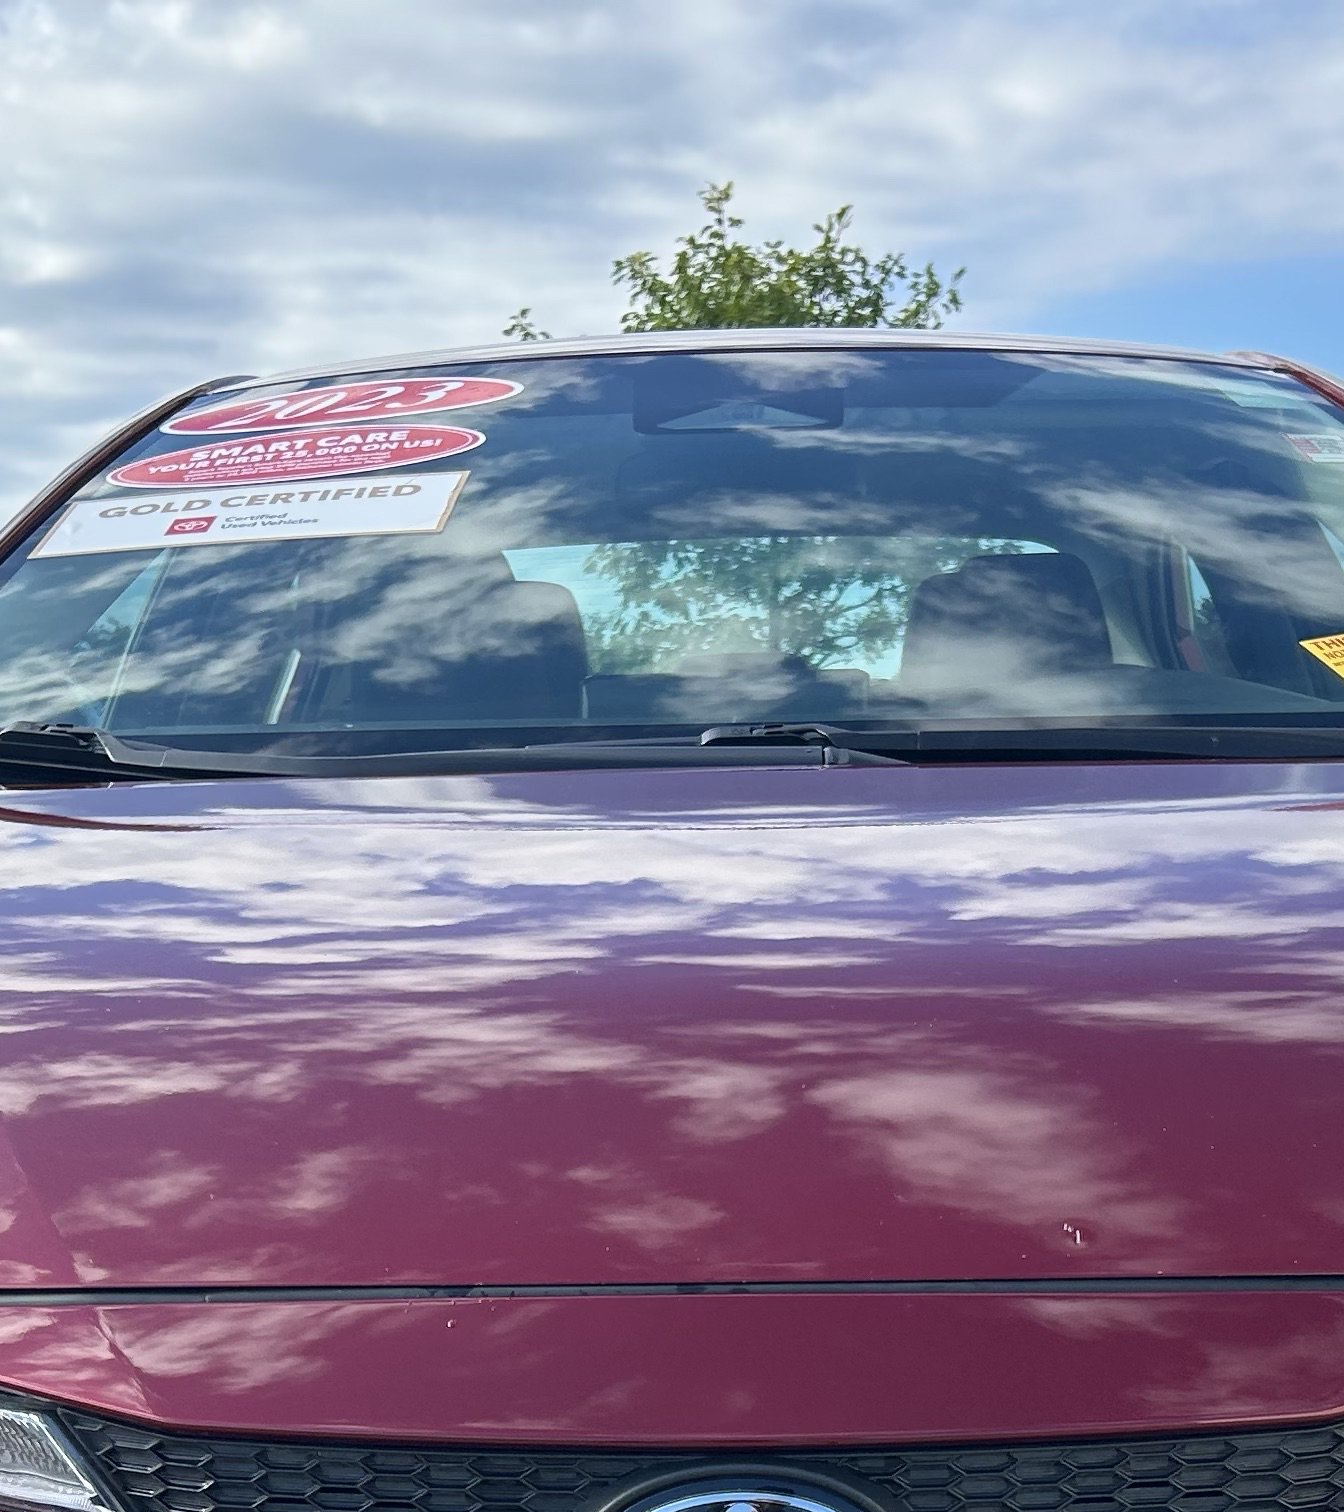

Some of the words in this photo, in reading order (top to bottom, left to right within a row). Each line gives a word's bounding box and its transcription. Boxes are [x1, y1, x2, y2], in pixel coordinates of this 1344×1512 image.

[207, 381, 465, 430] 2023
[145, 460, 211, 474] YOUR
[213, 453, 275, 467] FIRST
[361, 440, 398, 452] ON
[402, 438, 443, 448] US!
[189, 438, 313, 462] SMART
[316, 430, 411, 447] CARE
[98, 499, 212, 519] GOLD
[219, 483, 422, 508] CERTIFIED
[225, 512, 288, 523] Certified
[220, 521, 257, 530] Used
[261, 518, 319, 527] Vehicles
